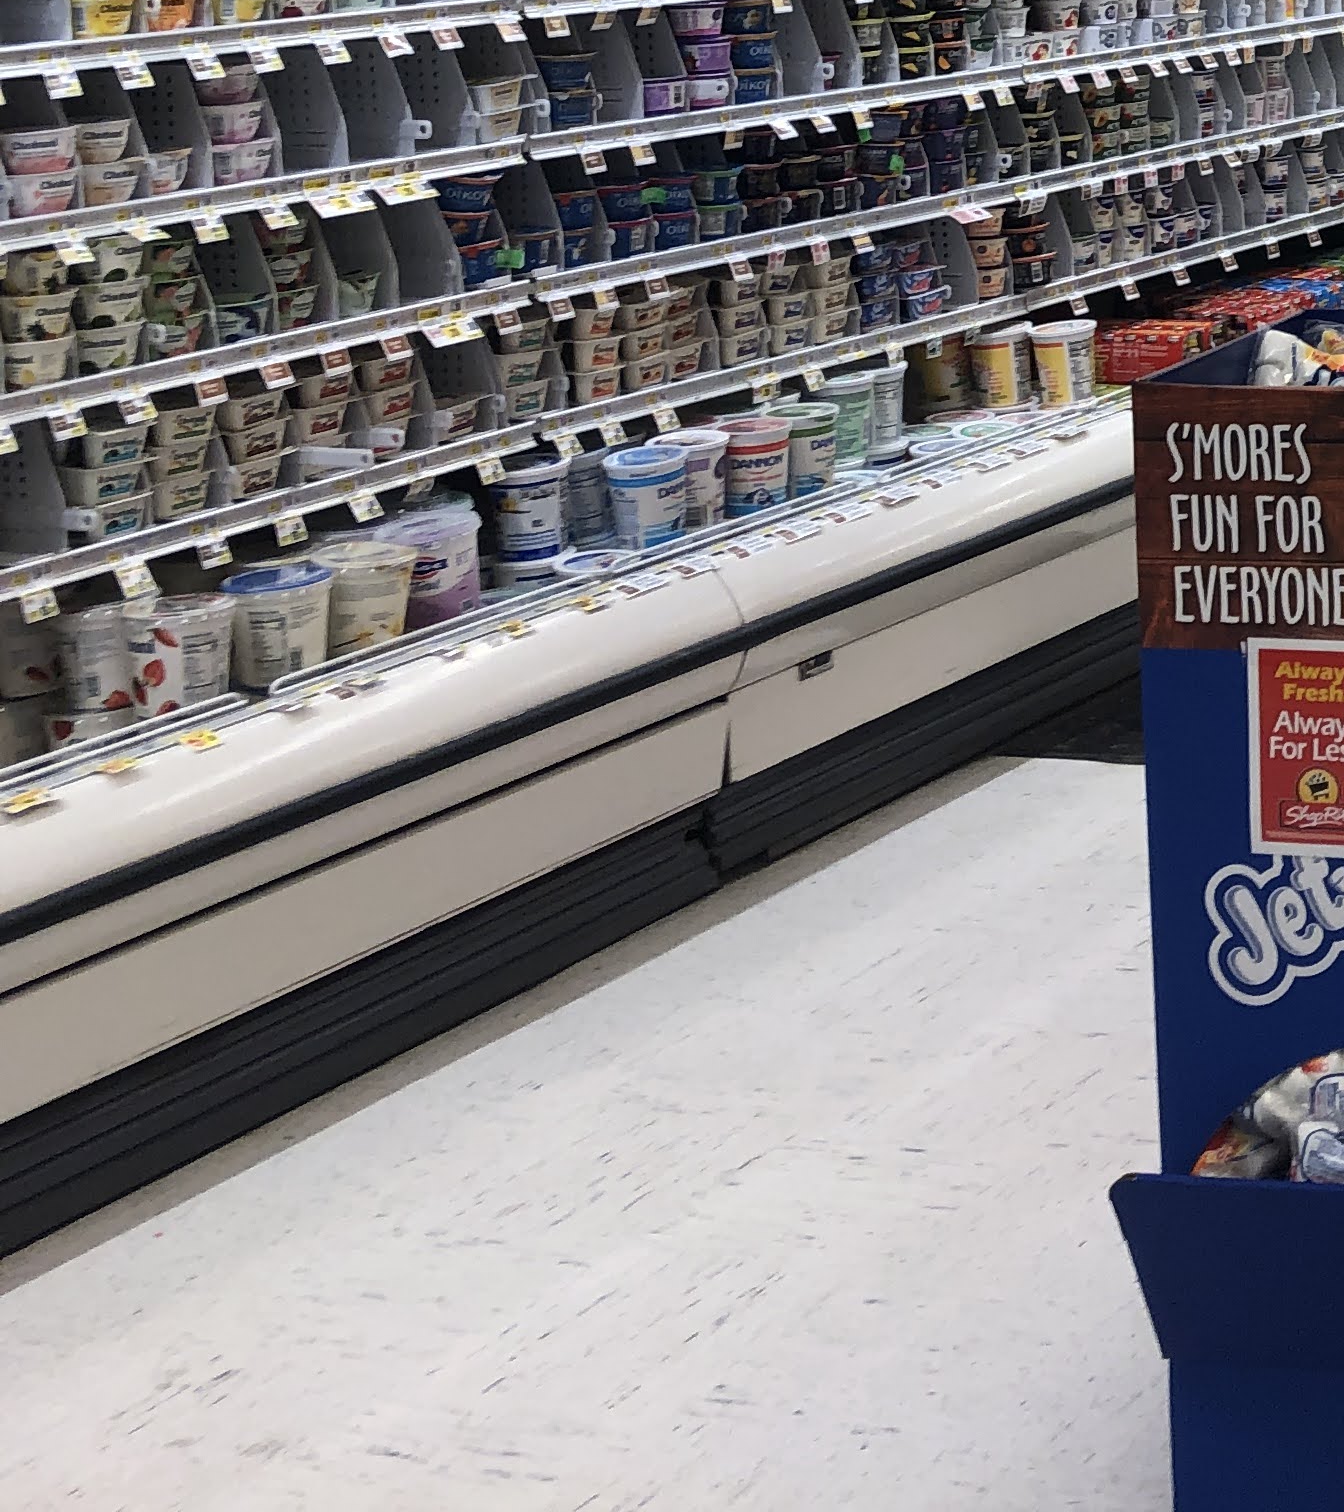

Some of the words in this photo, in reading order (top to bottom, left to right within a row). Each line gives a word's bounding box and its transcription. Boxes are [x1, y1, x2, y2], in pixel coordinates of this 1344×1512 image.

[732, 453, 784, 470] DANNON
[1166, 421, 1311, 484] S'MORES
[1170, 495, 1241, 553] FUN
[1257, 496, 1326, 554] FOR
[1269, 736, 1305, 760] For
